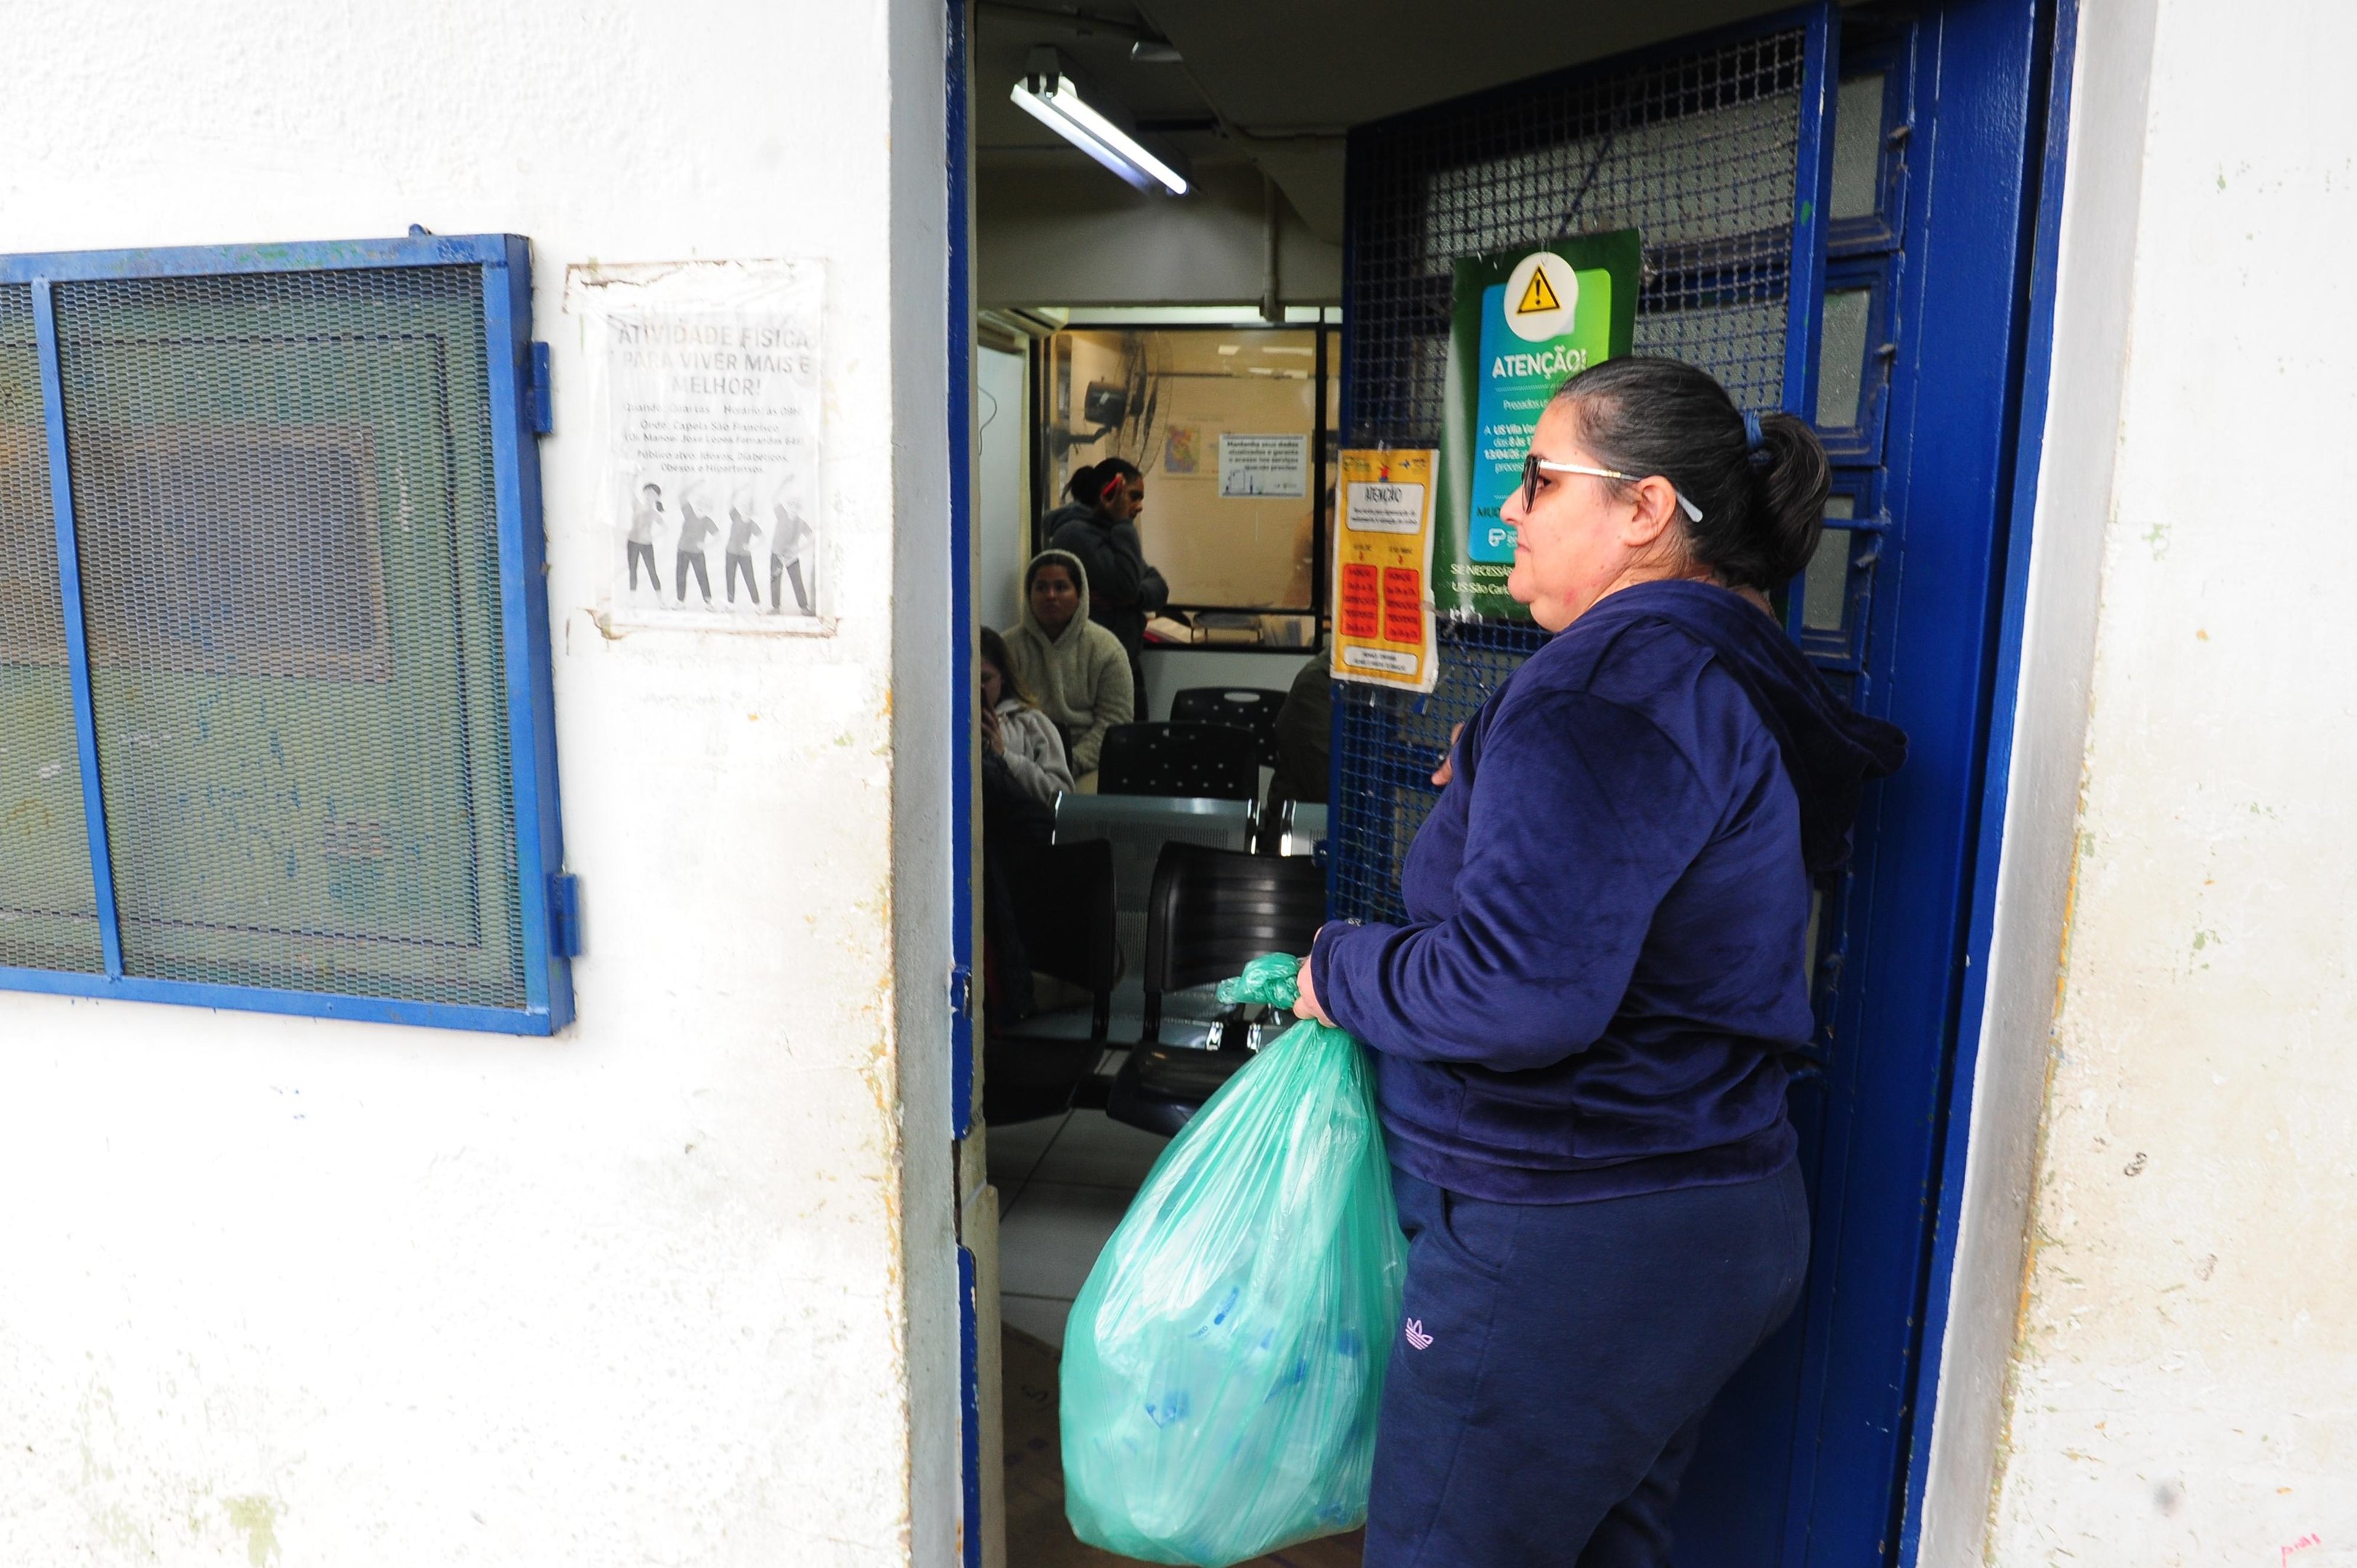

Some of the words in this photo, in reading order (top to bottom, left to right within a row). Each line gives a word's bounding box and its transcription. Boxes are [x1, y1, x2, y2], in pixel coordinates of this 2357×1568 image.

[618, 324, 732, 346] ATIVIDADE
[623, 351, 674, 369] PARA
[680, 352, 738, 371] VIVER
[744, 354, 793, 374] MAIS
[799, 356, 811, 375] E
[1492, 345, 1588, 380] ATENÇÃO!
[672, 375, 762, 396] MELHOR!
[1503, 397, 1540, 410] Prezados
[673, 420, 708, 433] Capela
[711, 420, 730, 431] São
[732, 421, 779, 433] Francisco
[1483, 424, 1492, 436] A
[1492, 424, 1507, 436] US
[1506, 423, 1522, 435] Vila
[637, 449, 671, 460] Público
[661, 462, 695, 474] Obesos
[1365, 485, 1402, 504] ATENÇÃO
[1450, 563, 1466, 575] SE
[1452, 581, 1468, 593] US
[1468, 582, 1488, 594] São
